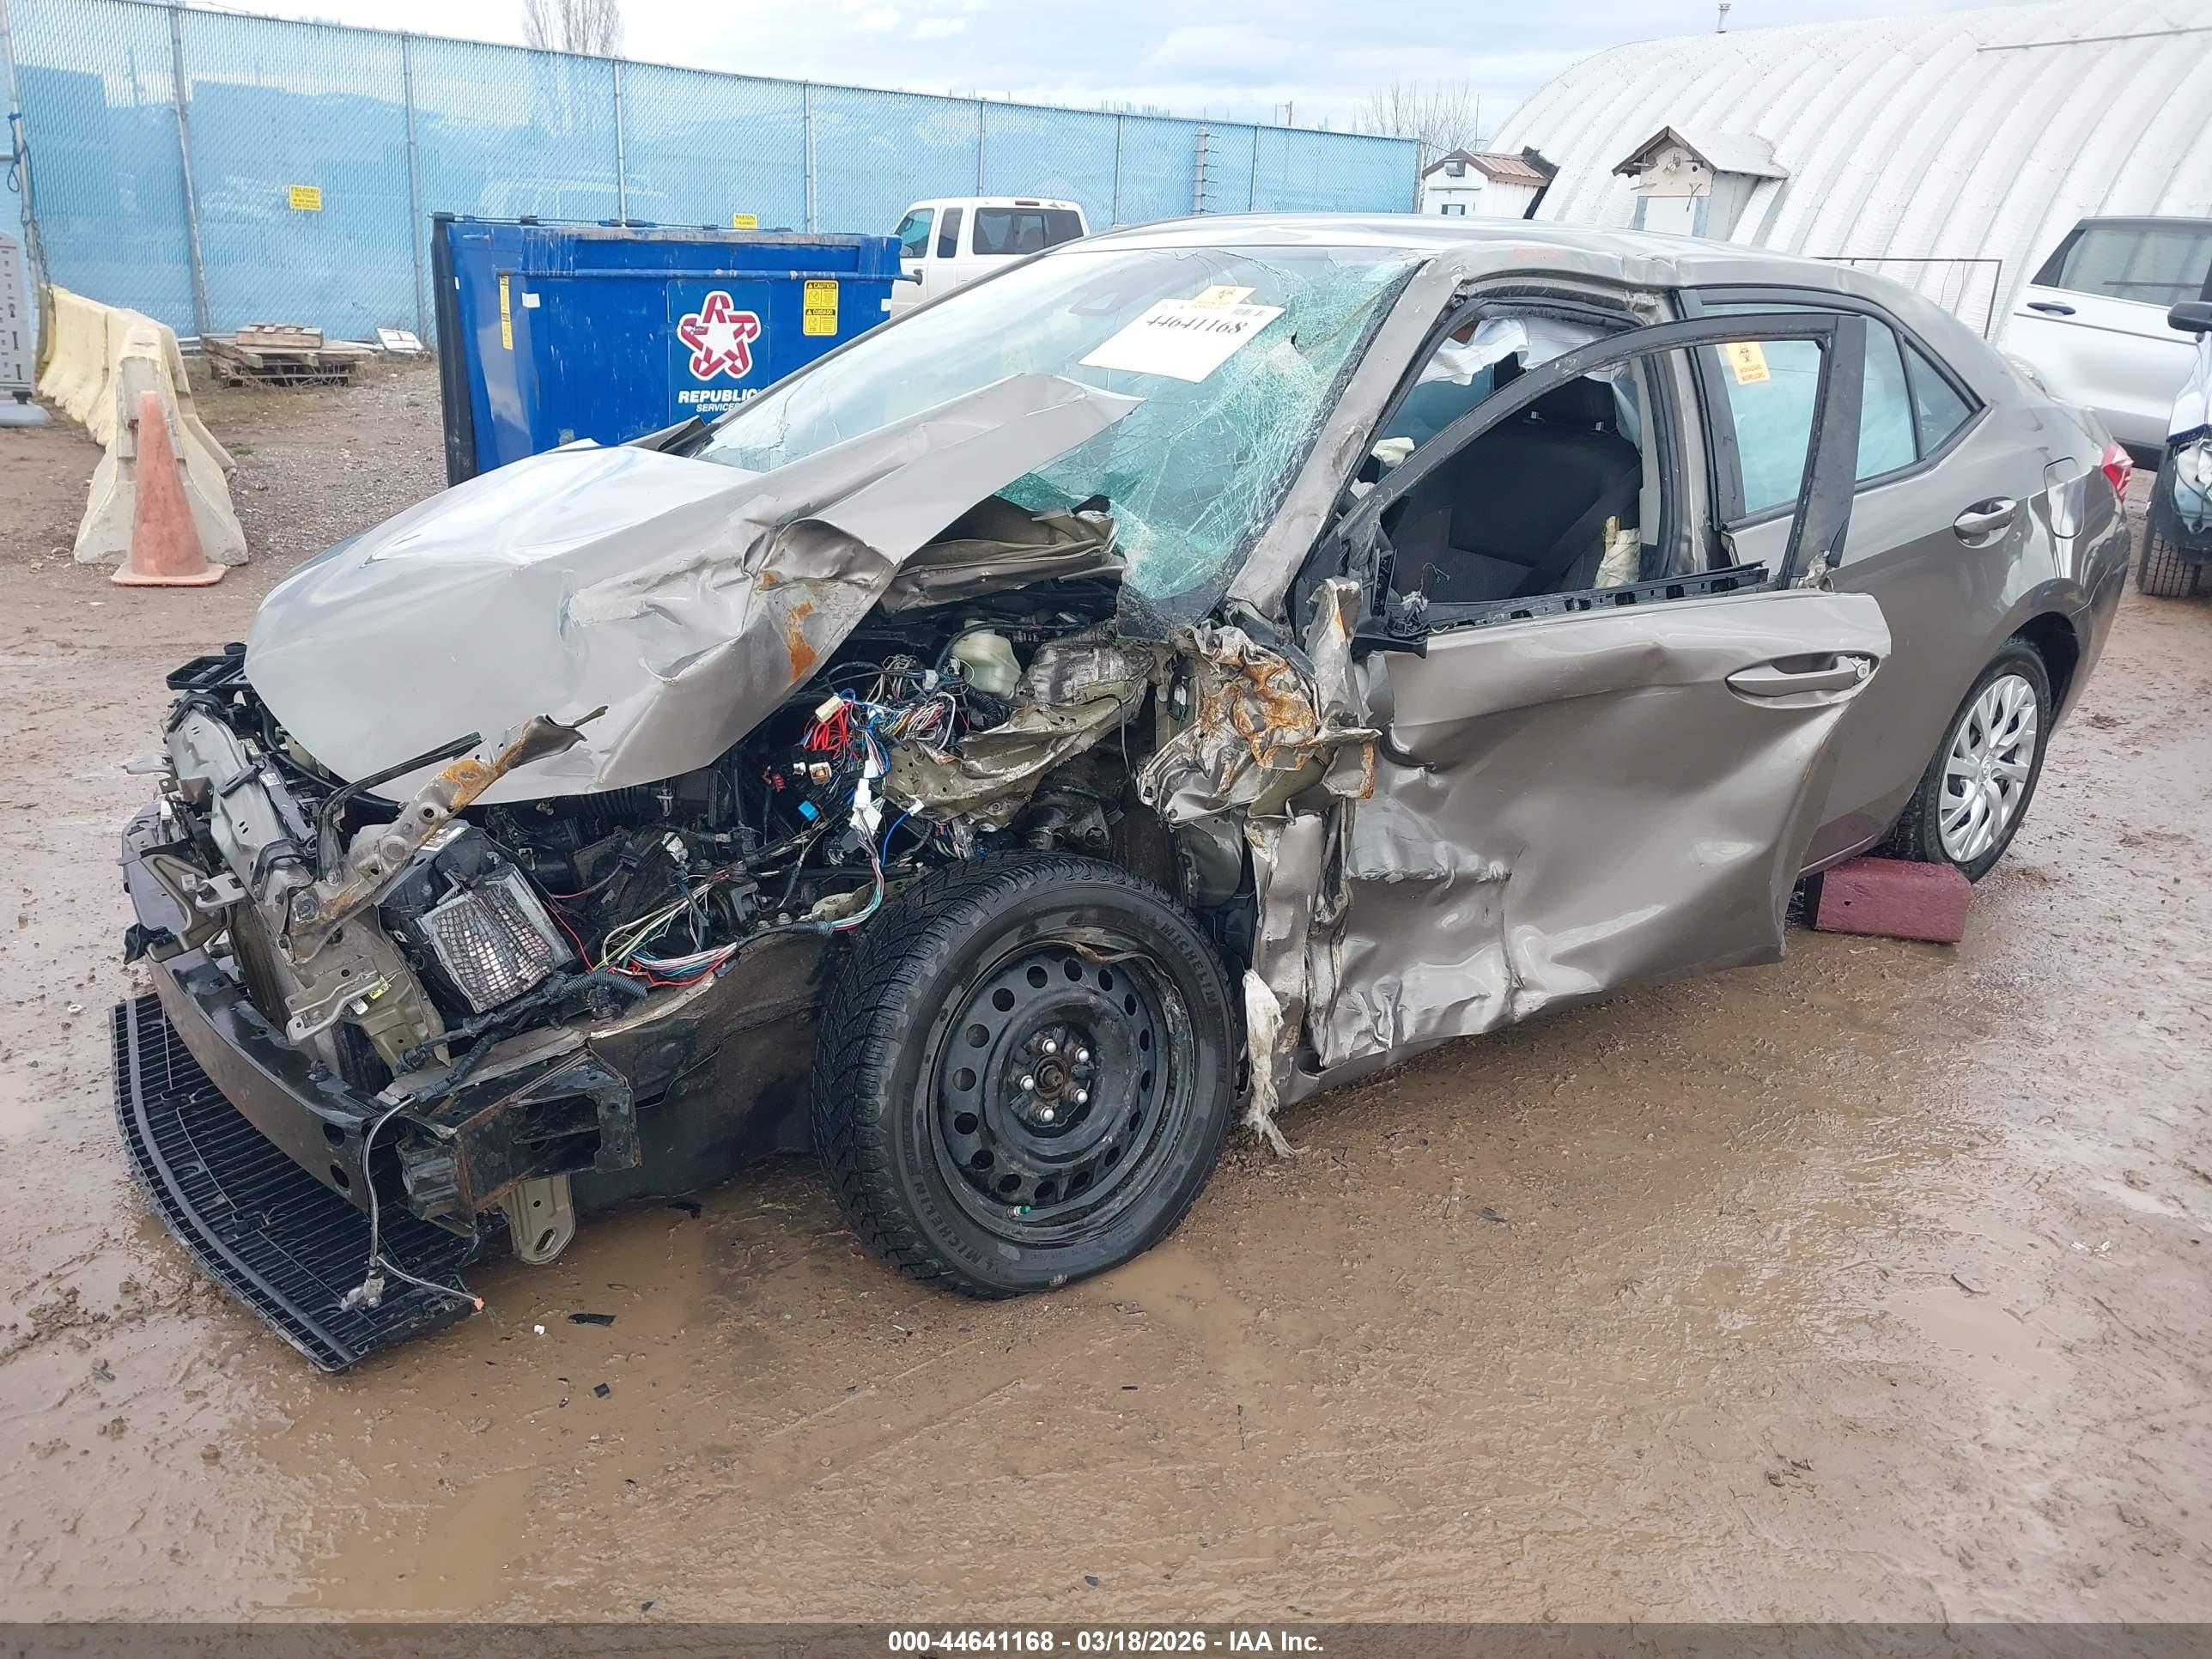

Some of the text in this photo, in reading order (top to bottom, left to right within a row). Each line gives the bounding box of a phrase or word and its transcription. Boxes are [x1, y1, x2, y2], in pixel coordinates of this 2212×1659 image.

[1146, 314, 1249, 334] 44641168
[678, 388, 759, 404] REPUBLIC
[1160, 922, 1218, 1003] MICHELIN
[914, 1182, 982, 1265] MICHELIN
